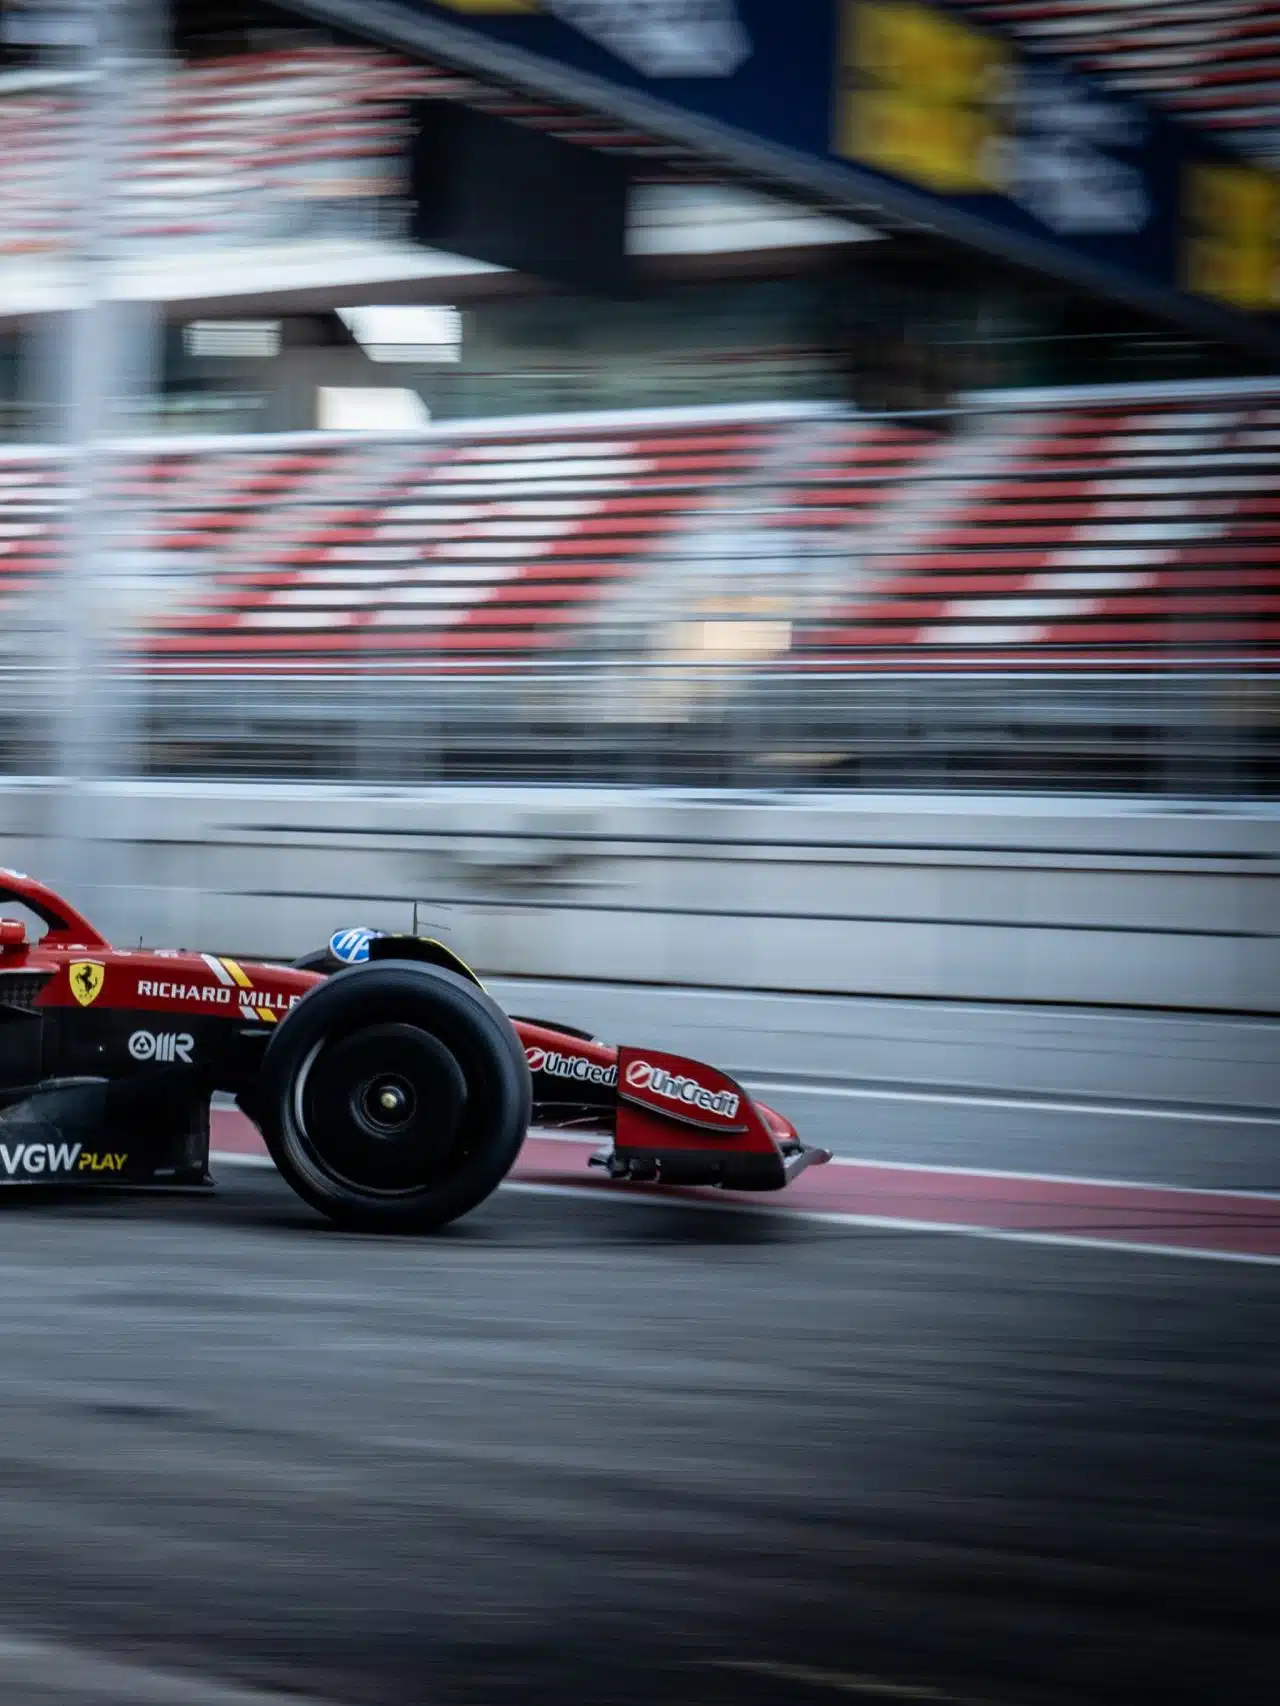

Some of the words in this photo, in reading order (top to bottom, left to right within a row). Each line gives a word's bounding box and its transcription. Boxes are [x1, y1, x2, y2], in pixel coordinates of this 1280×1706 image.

[138, 980, 231, 1004] RICHARD
[544, 1053, 618, 1085] UniCredi
[652, 1070, 737, 1116] UniCredit
[0, 1143, 82, 1174] VGW
[78, 1153, 128, 1170] PLAY
